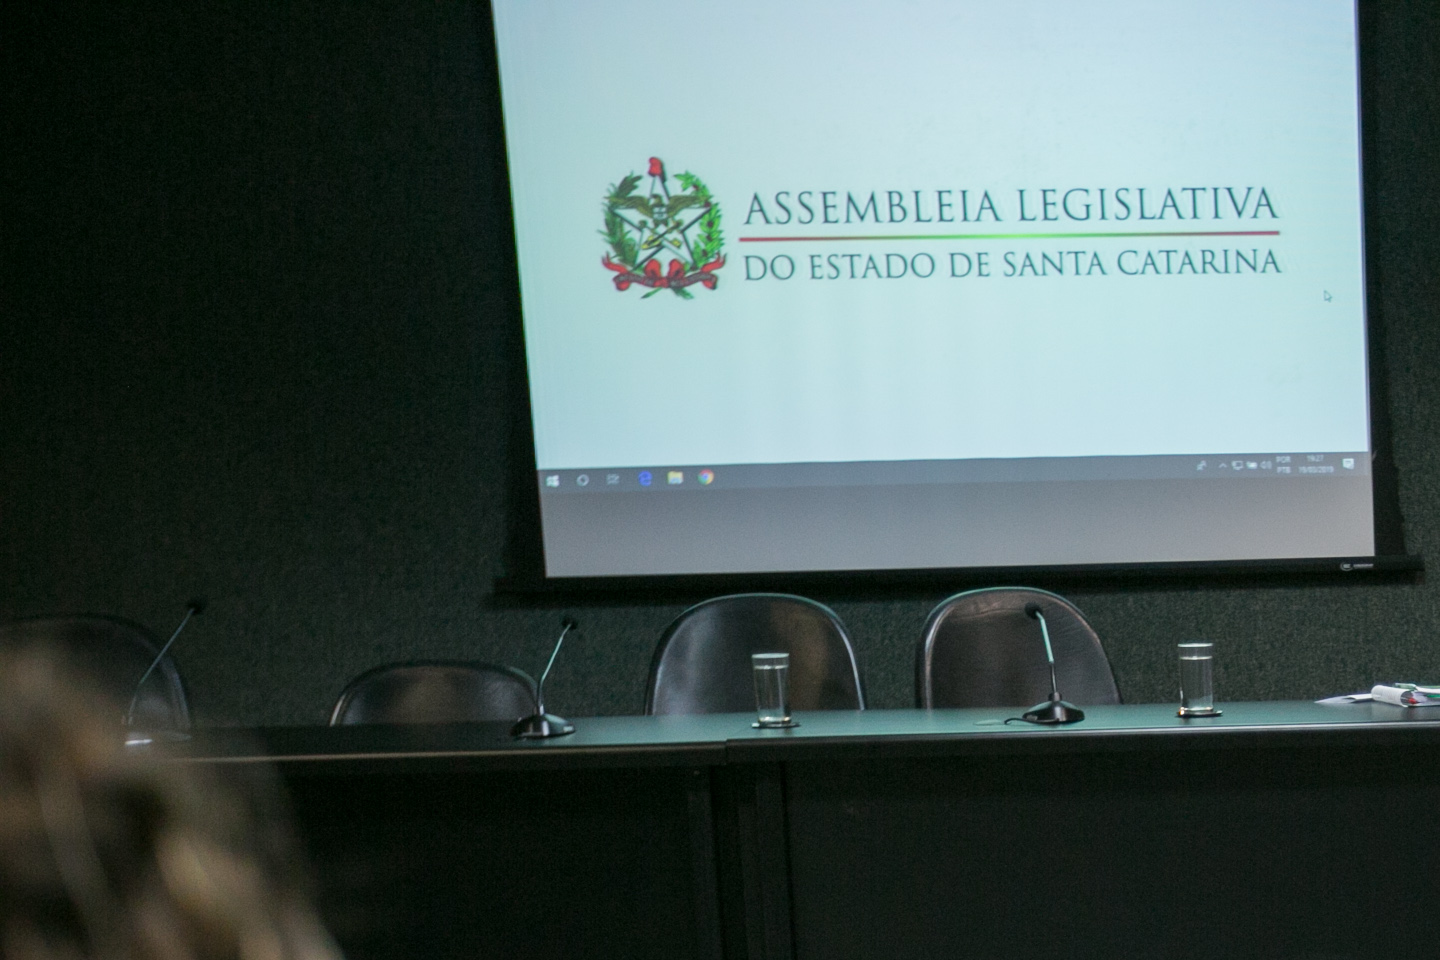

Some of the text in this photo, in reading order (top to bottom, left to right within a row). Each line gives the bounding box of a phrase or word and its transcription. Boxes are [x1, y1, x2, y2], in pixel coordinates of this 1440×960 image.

[743, 186, 1280, 226] ASSEMBLEIA LEGISLATIVA
[743, 253, 796, 282] DO
[809, 252, 936, 280] ESTADO
[949, 251, 991, 278] DE
[1002, 250, 1108, 278] SANTA
[1117, 248, 1283, 276] CATARINA
